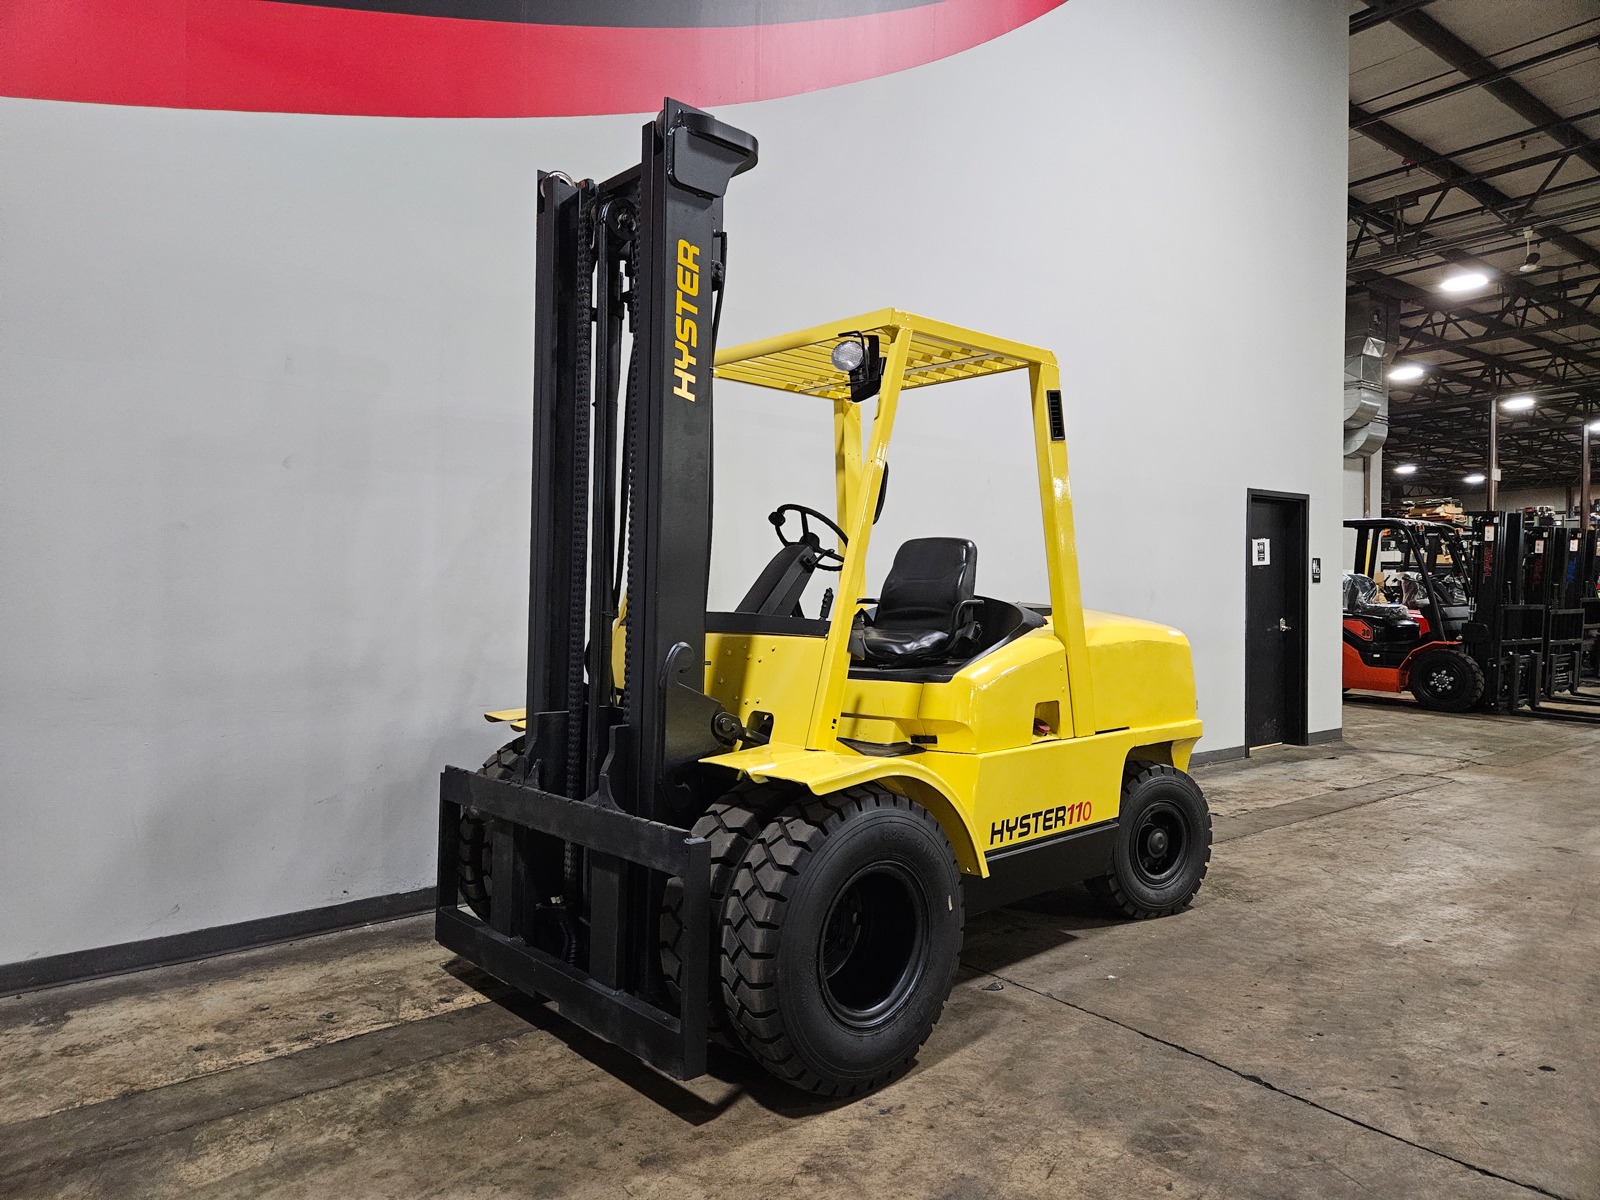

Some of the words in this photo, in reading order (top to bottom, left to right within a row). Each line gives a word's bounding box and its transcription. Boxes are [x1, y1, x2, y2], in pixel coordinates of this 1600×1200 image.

[673, 238, 700, 403] HYSTER
[989, 805, 1067, 846] HYSTER
[1066, 800, 1092, 825] 110
